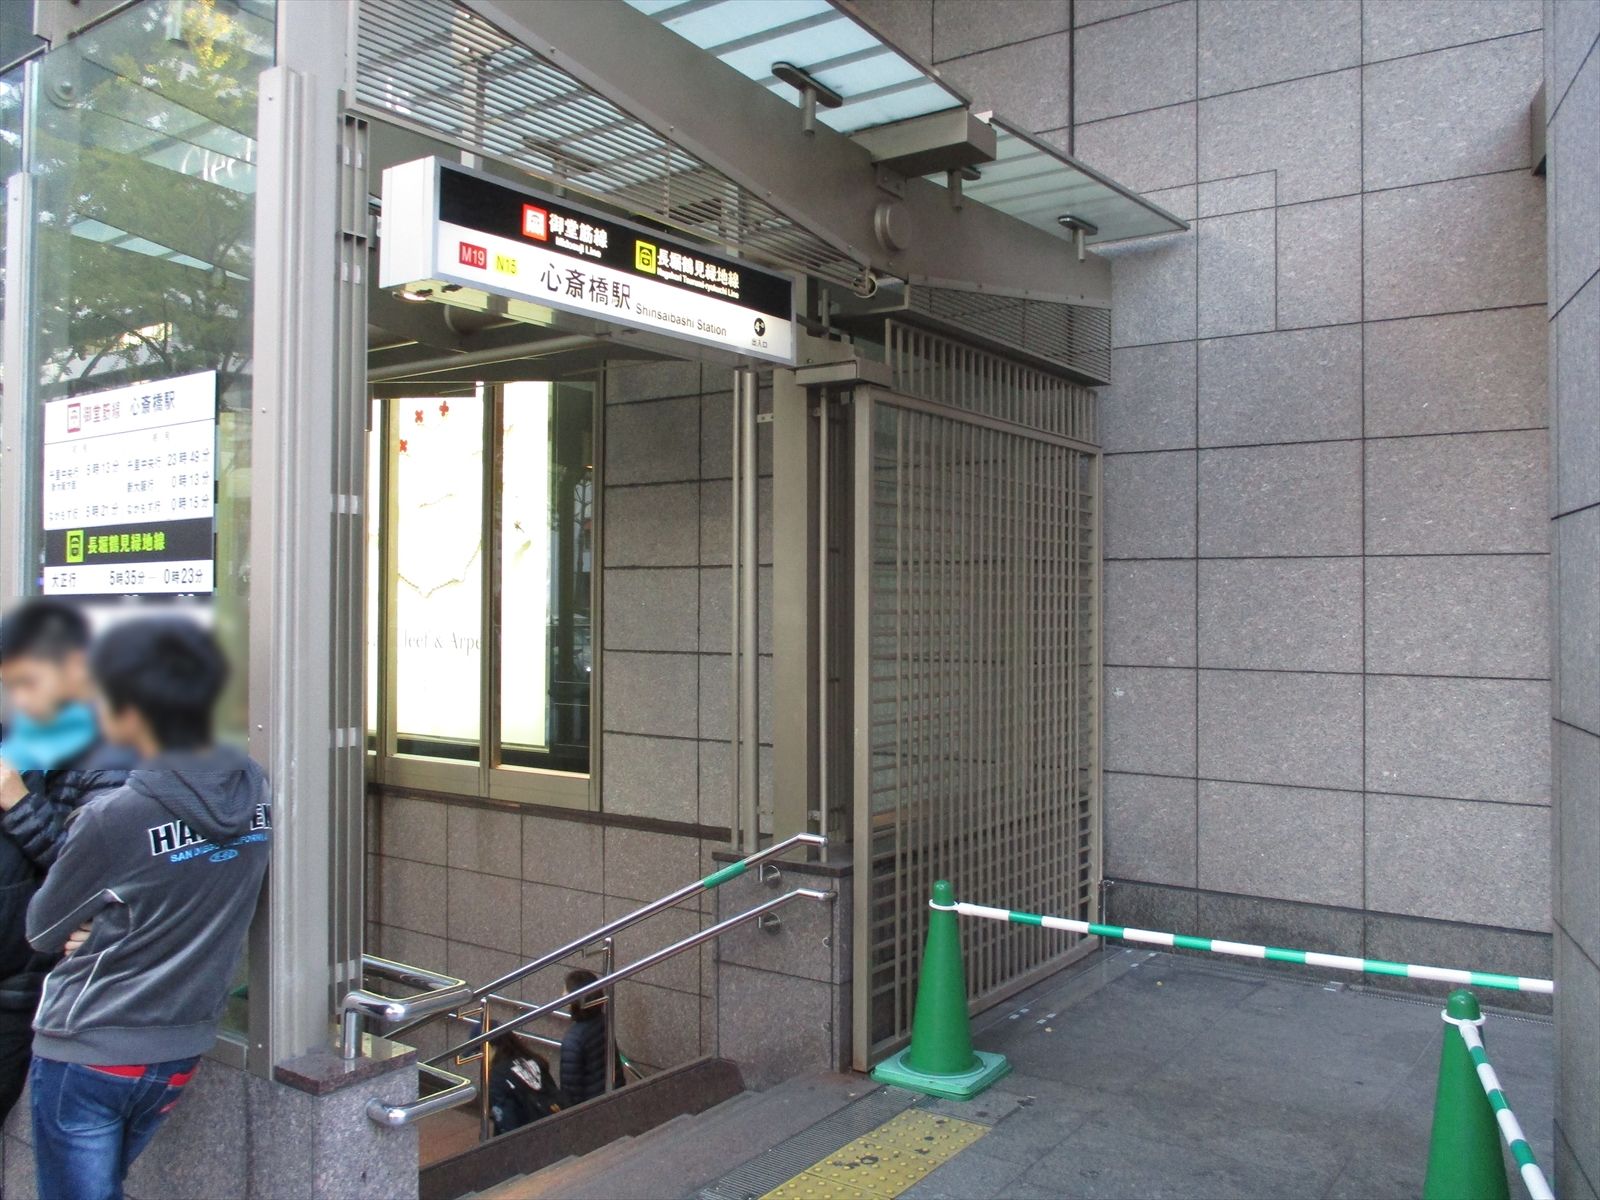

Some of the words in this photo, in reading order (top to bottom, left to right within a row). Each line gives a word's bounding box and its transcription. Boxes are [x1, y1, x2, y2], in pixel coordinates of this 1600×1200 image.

[549, 213, 609, 249] 御堂筋線
[461, 244, 485, 266] M19
[496, 255, 517, 275] N15
[656, 248, 740, 289] 長堀鶴見緑地線
[540, 263, 631, 310] 心斎橋駅
[635, 302, 695, 328] Shinsaibashi
[697, 319, 727, 337] Station
[130, 390, 176, 417] 心斎橋駅
[87, 531, 166, 554] 長堀鶴見緑地線
[51, 572, 77, 588] 大正行
[109, 569, 145, 586] 5時35分
[163, 567, 204, 585] 0時23分
[169, 848, 193, 864] SAN
